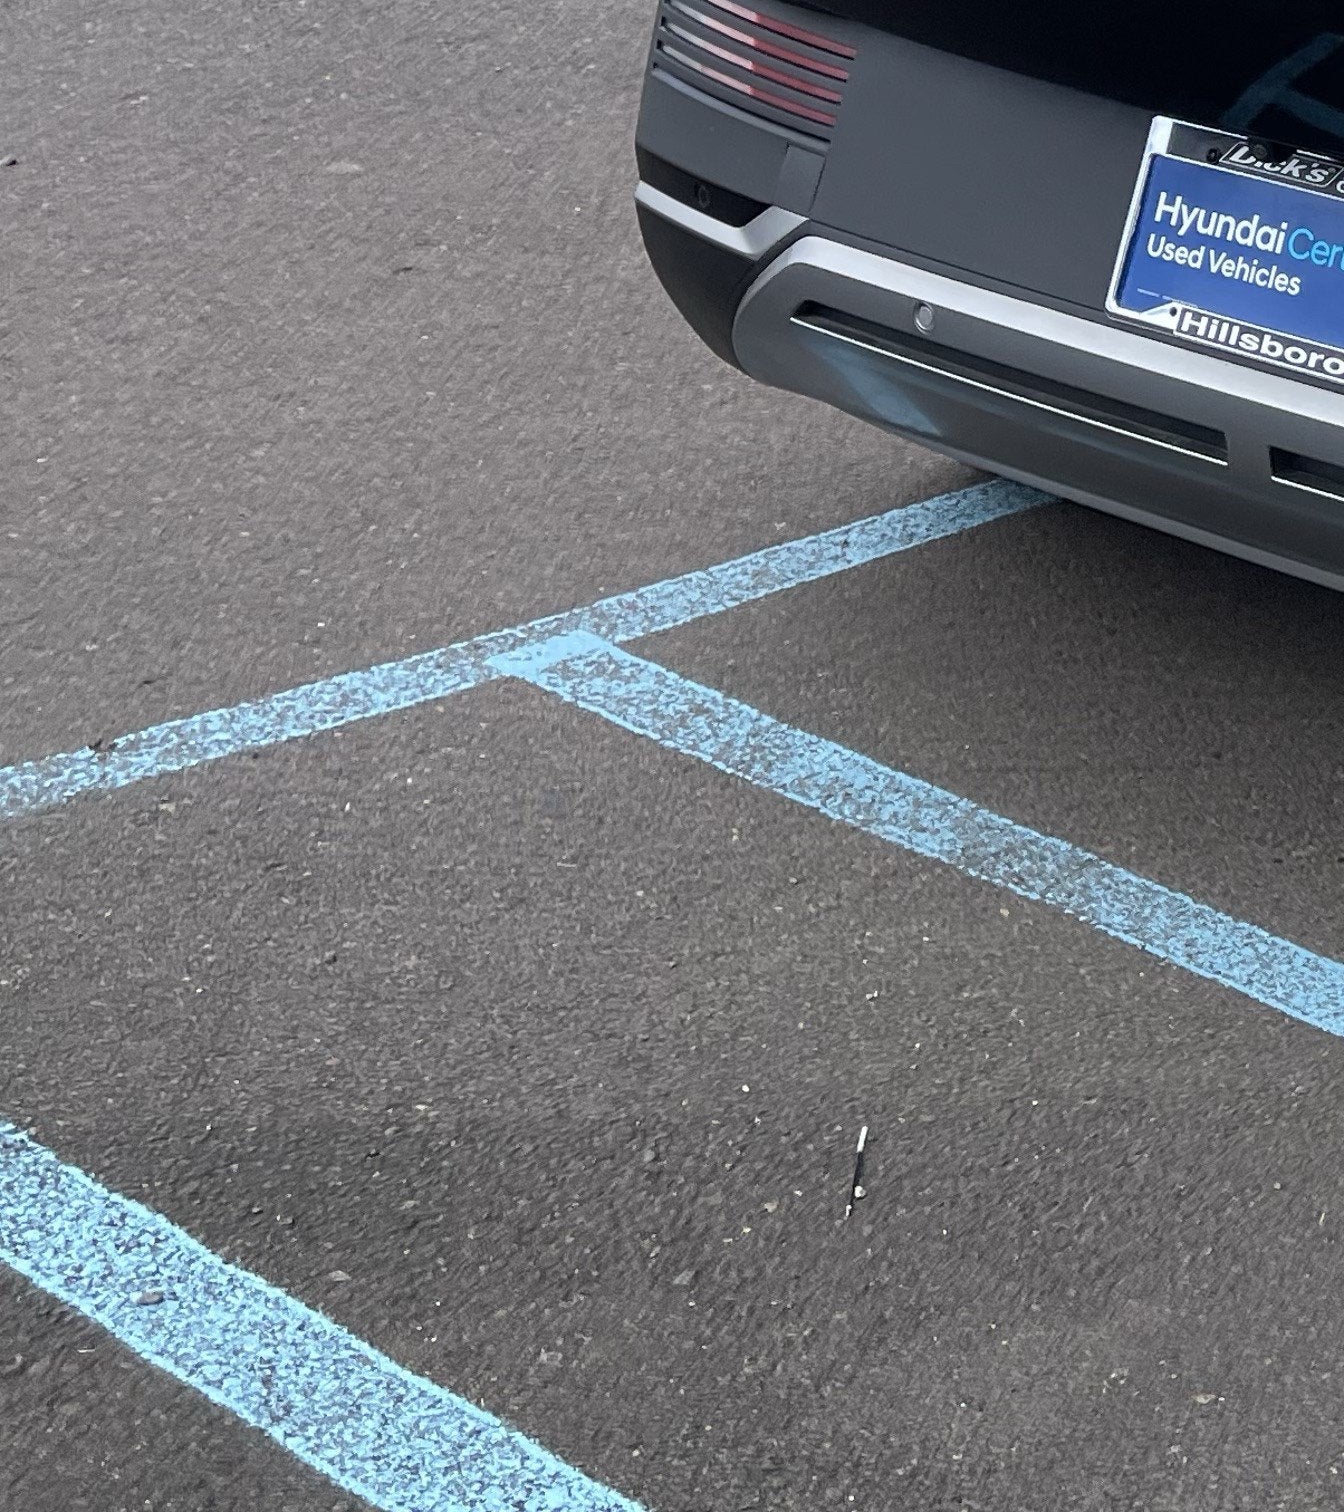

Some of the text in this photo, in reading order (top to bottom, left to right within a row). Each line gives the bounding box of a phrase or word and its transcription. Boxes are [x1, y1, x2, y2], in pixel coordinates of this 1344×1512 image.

[1153, 190, 1289, 255] Hyundai
[1146, 232, 1302, 296] Used Vehicles
